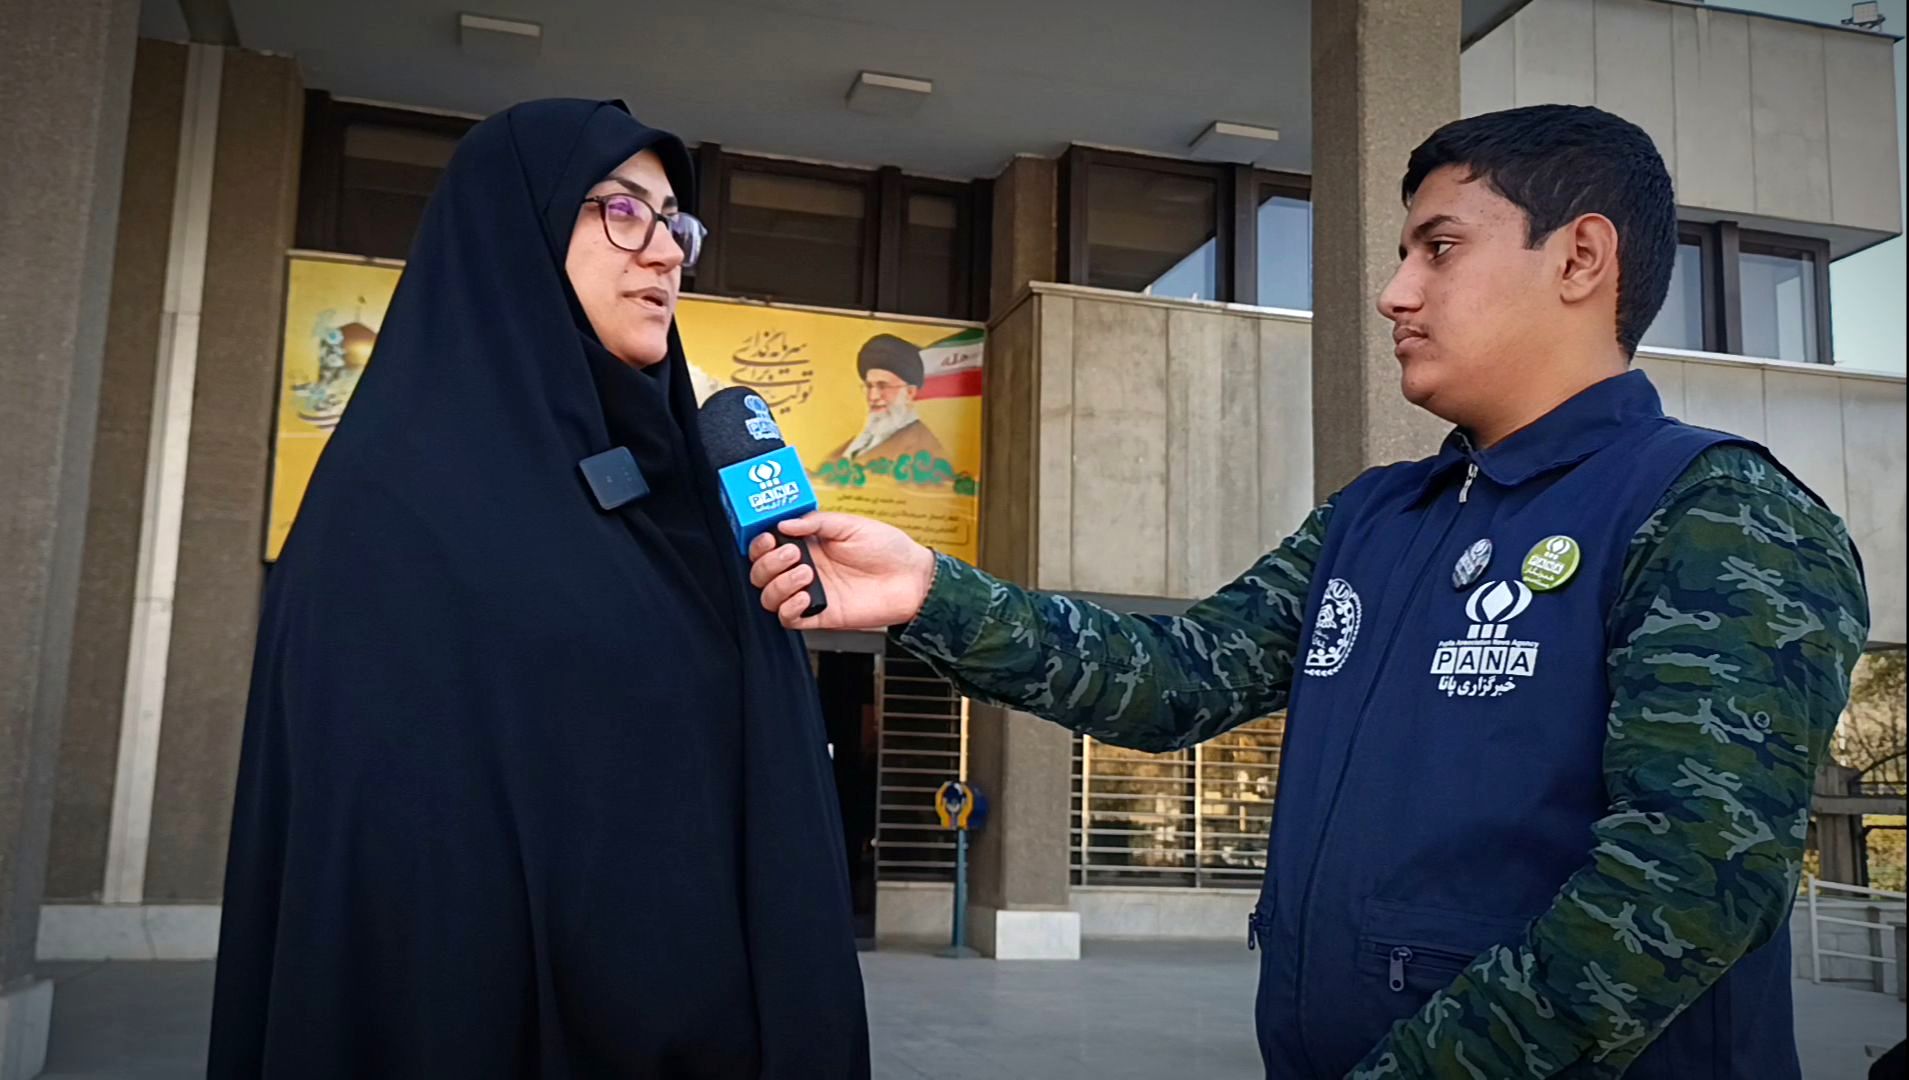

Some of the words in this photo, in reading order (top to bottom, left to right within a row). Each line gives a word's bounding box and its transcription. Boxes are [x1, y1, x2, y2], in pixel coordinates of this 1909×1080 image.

[750, 483, 798, 506] PANA
[1511, 639, 1540, 649] Agency
[1433, 648, 1533, 674] PANA
[1438, 675, 1457, 697] پانا
[1457, 675, 1516, 697] خبرگزاری
